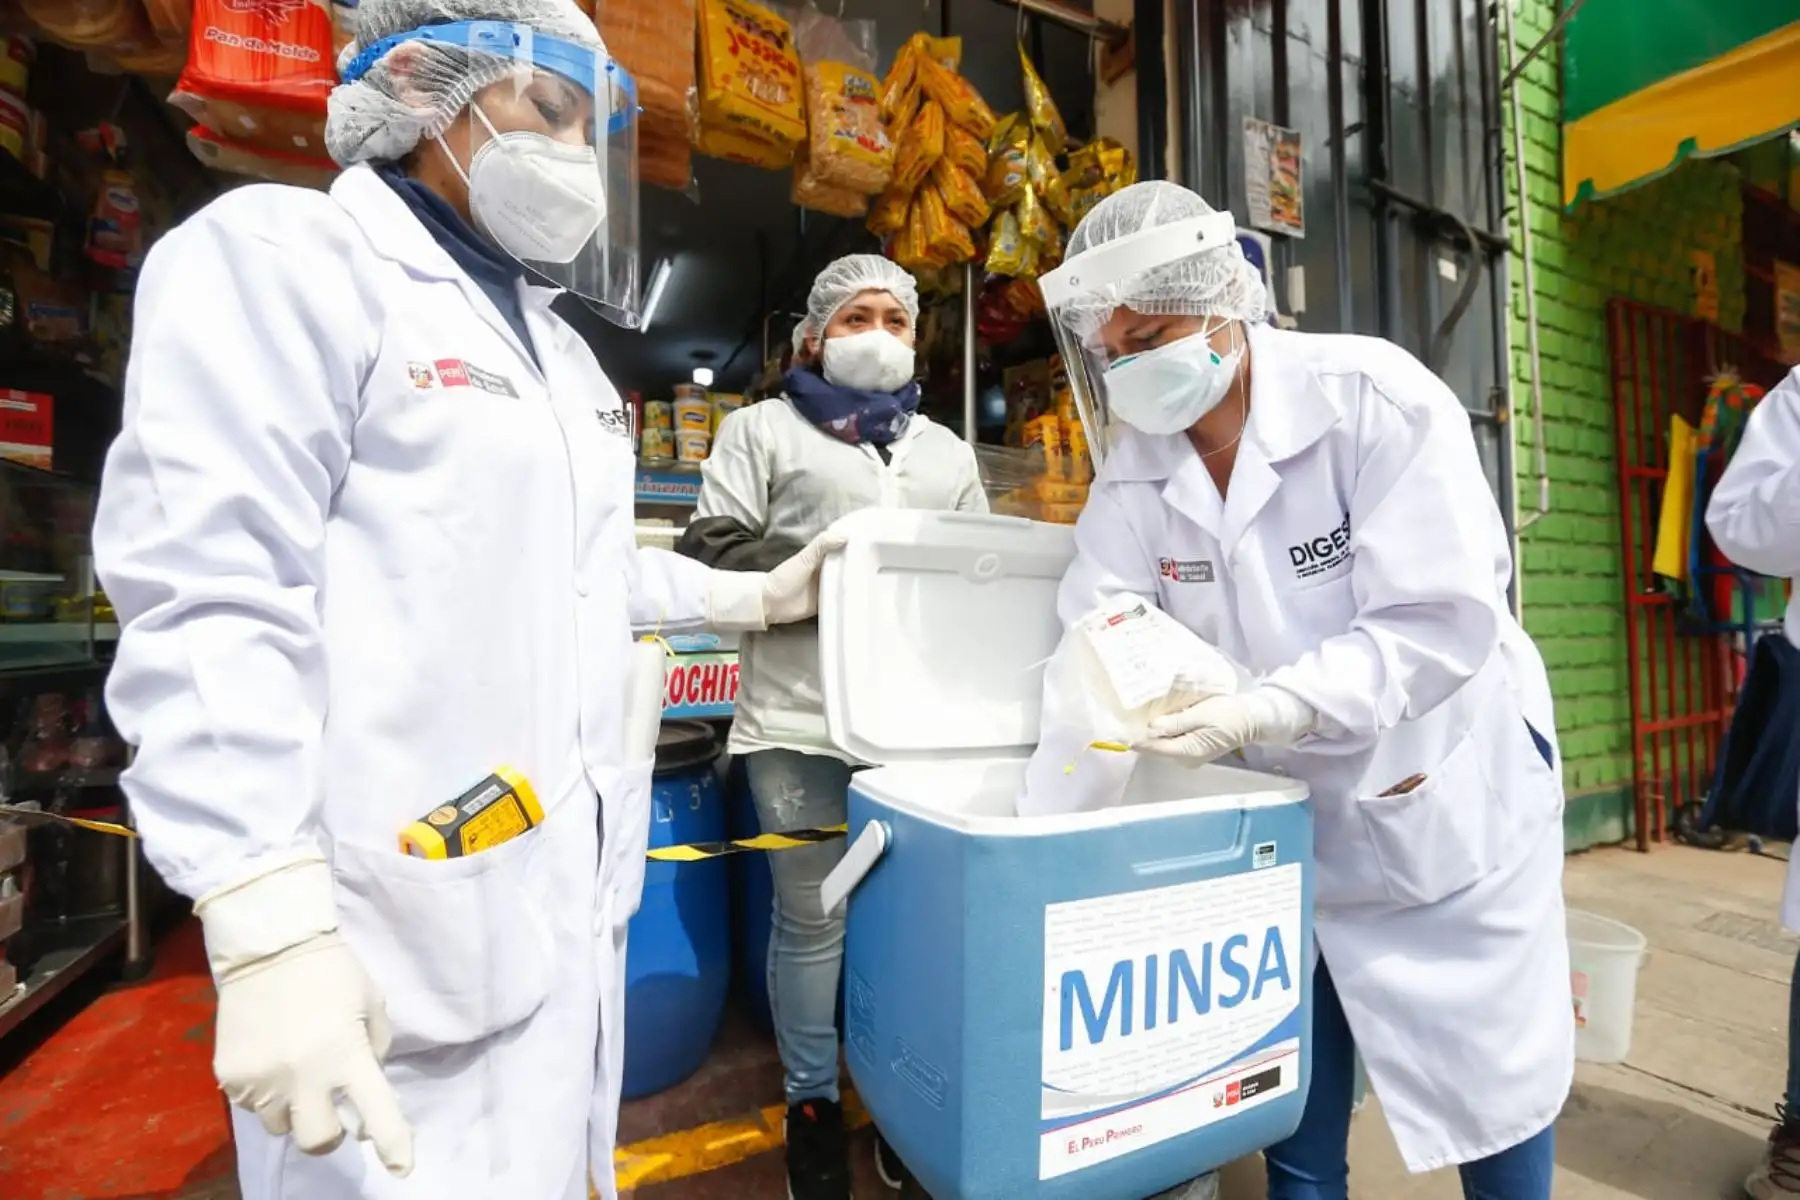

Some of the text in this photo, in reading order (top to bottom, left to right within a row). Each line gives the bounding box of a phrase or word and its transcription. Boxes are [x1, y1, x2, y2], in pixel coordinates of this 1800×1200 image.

[205, 27, 319, 61] Pan de Molde
[662, 663, 741, 708] OCHIP
[1059, 925, 1292, 1052] MINSA
